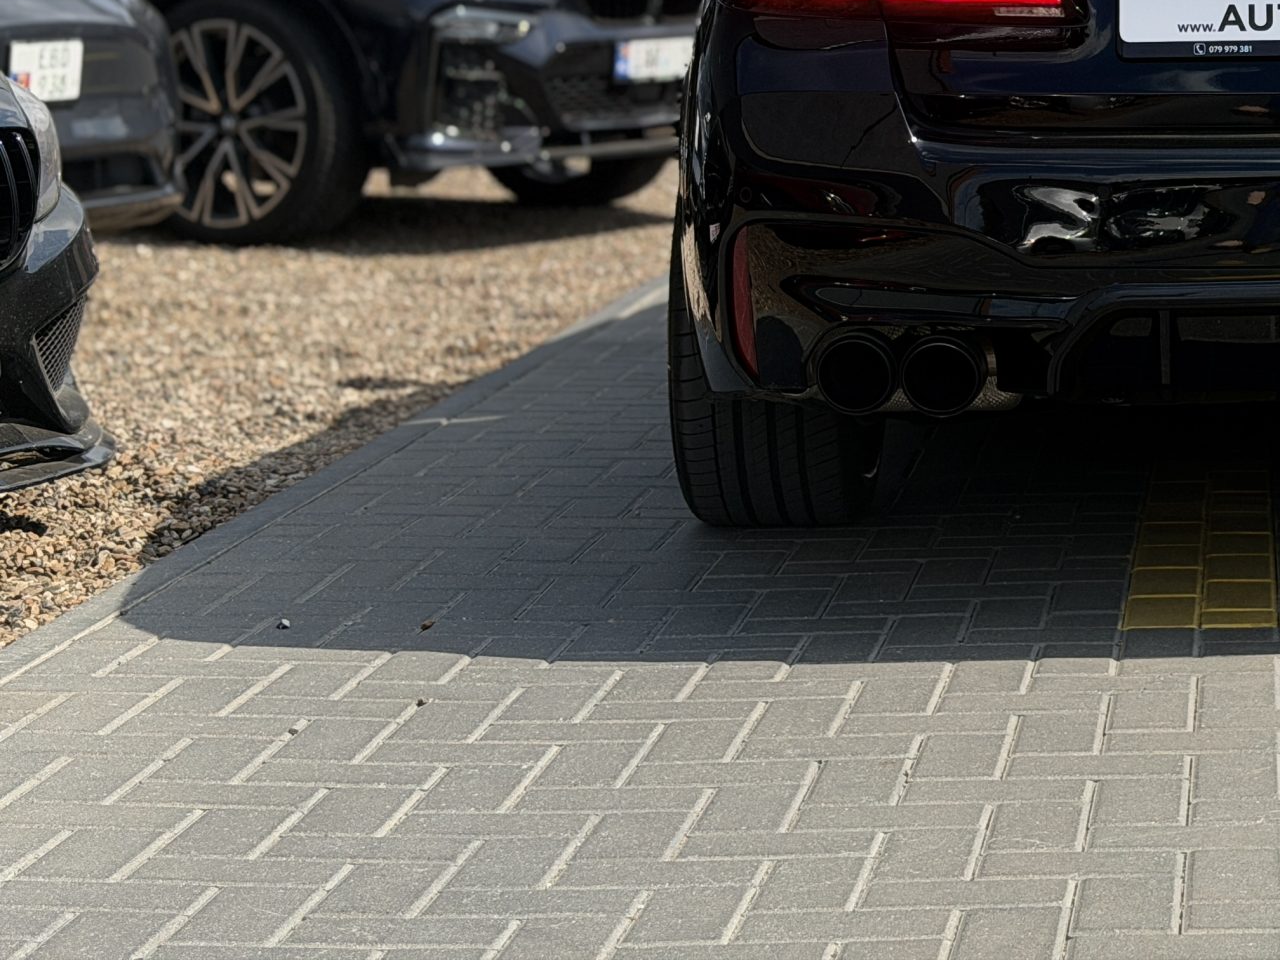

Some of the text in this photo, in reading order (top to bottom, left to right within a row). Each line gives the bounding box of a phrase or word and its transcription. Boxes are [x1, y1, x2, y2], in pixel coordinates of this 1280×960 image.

[1209, 45, 1252, 54] 079 979 381
